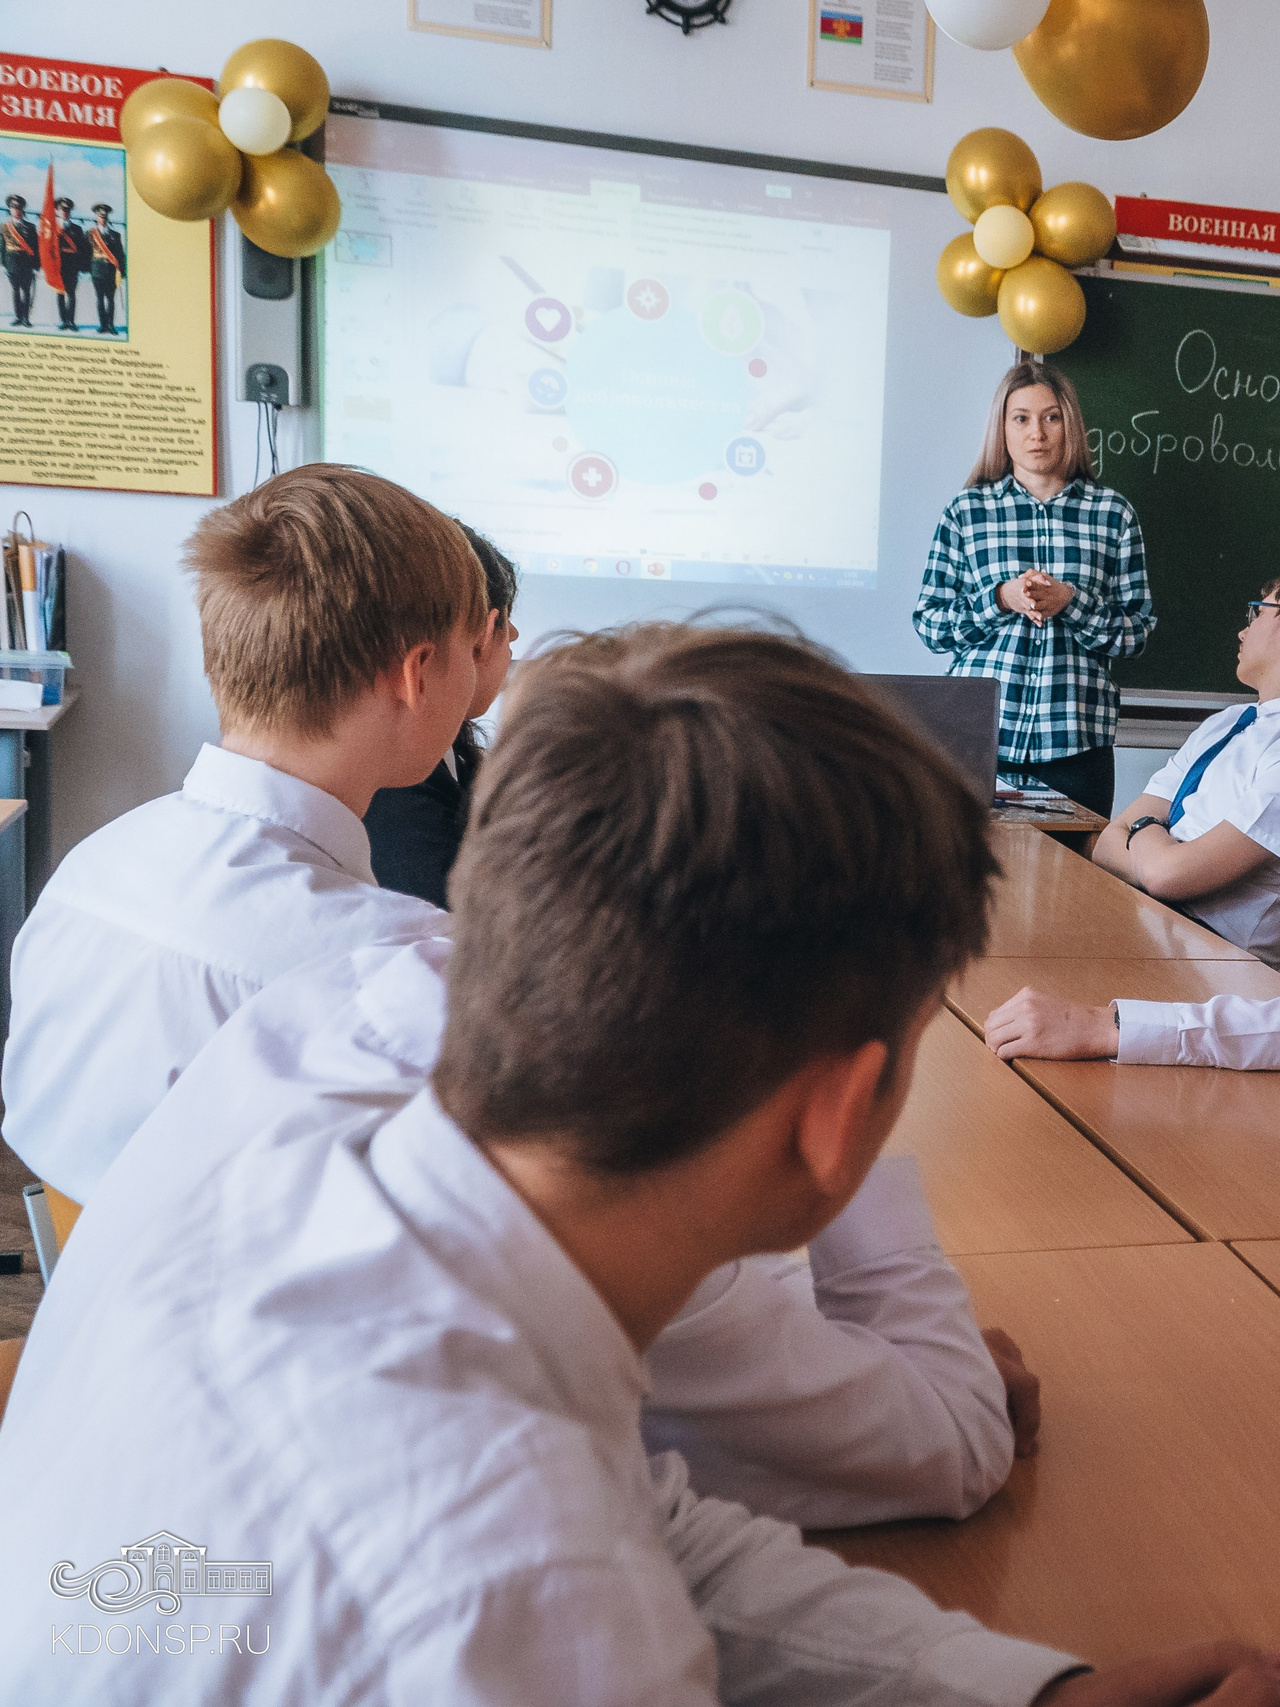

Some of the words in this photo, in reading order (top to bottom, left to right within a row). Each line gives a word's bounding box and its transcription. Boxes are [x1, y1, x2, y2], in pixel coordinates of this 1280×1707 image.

[0, 64, 123, 99] БОЕВОЕ
[1, 93, 118, 129] ЗНАМЯ
[1168, 213, 1277, 242] ВОЕННАЯ
[50, 352, 107, 364] Российской
[129, 400, 186, 413] Российской
